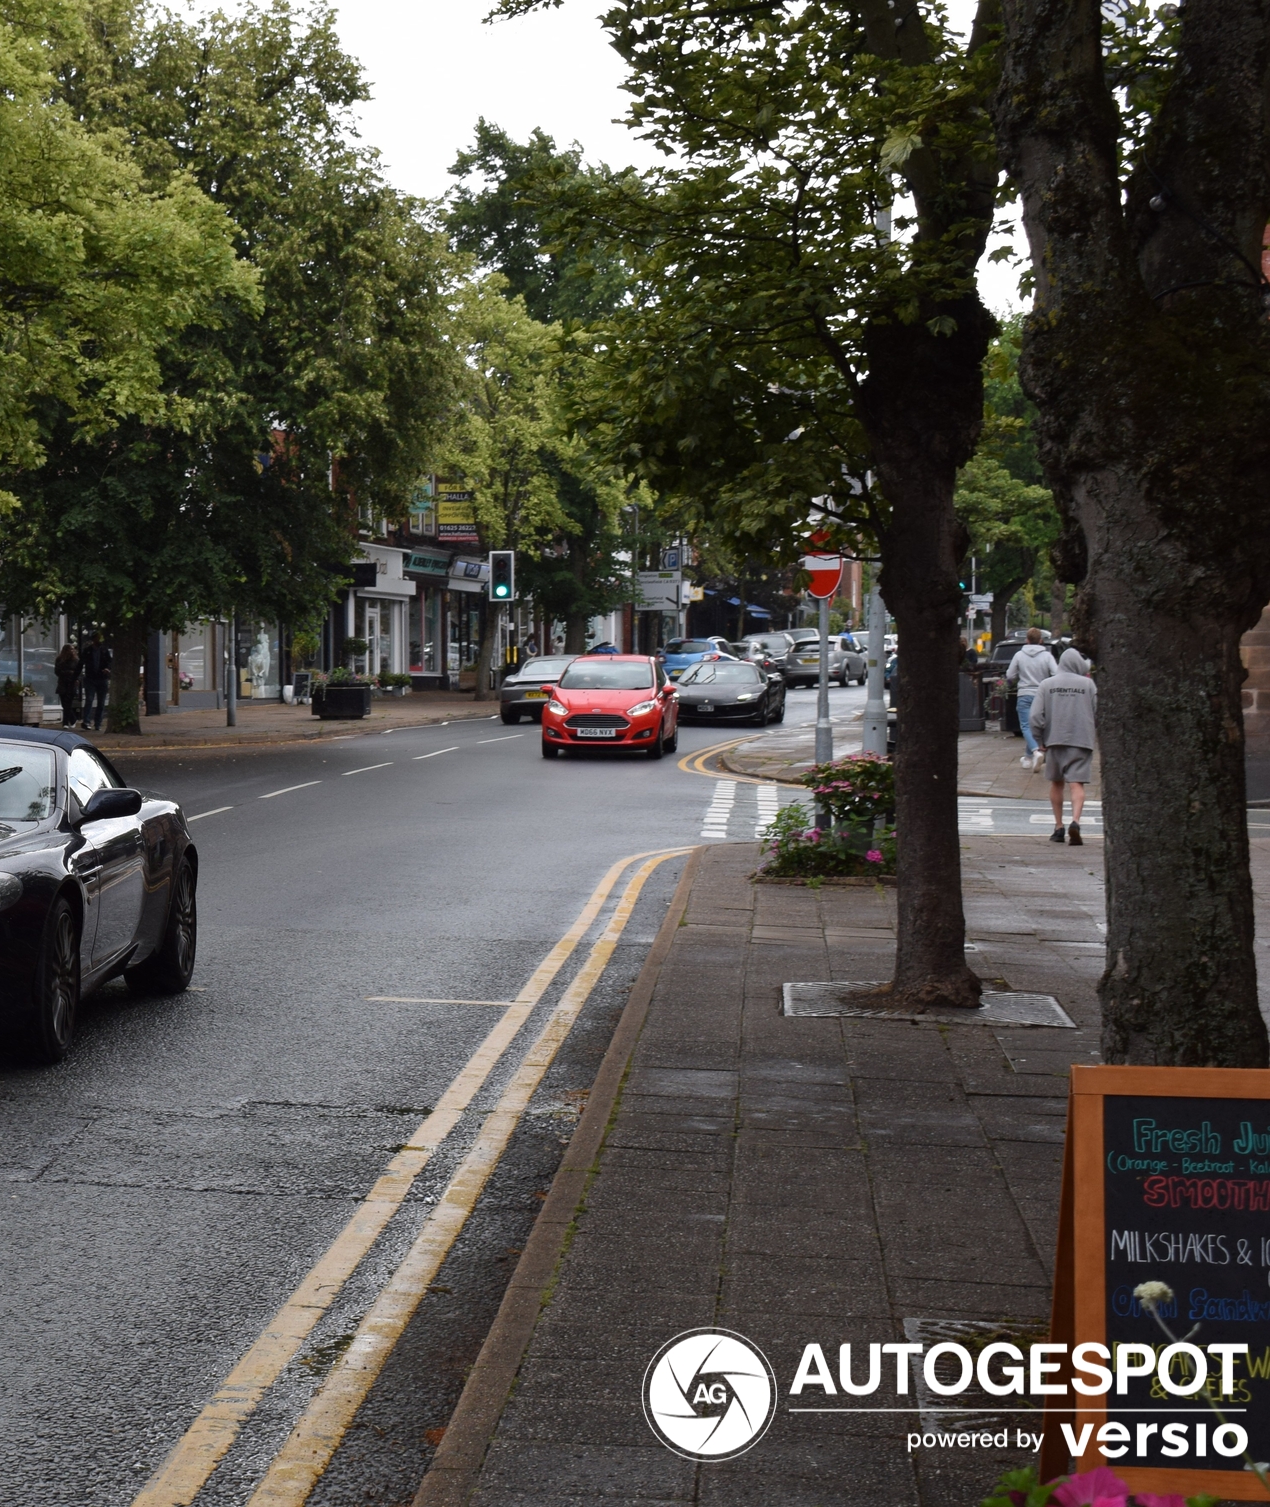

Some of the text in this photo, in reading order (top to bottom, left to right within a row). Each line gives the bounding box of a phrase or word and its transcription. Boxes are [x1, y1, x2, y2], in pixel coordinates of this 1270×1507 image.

[1132, 1118, 1221, 1154] Fresh
[1107, 1150, 1170, 1174] (Orange
[1182, 1158, 1234, 1174] Beetroot
[1250, 1159, 1270, 1174] Kal
[1143, 1175, 1270, 1211] SMOOTH
[1111, 1229, 1230, 1264] MILKSHAKES
[1237, 1238, 1251, 1266] &
[1180, 1376, 1252, 1402] CEES
